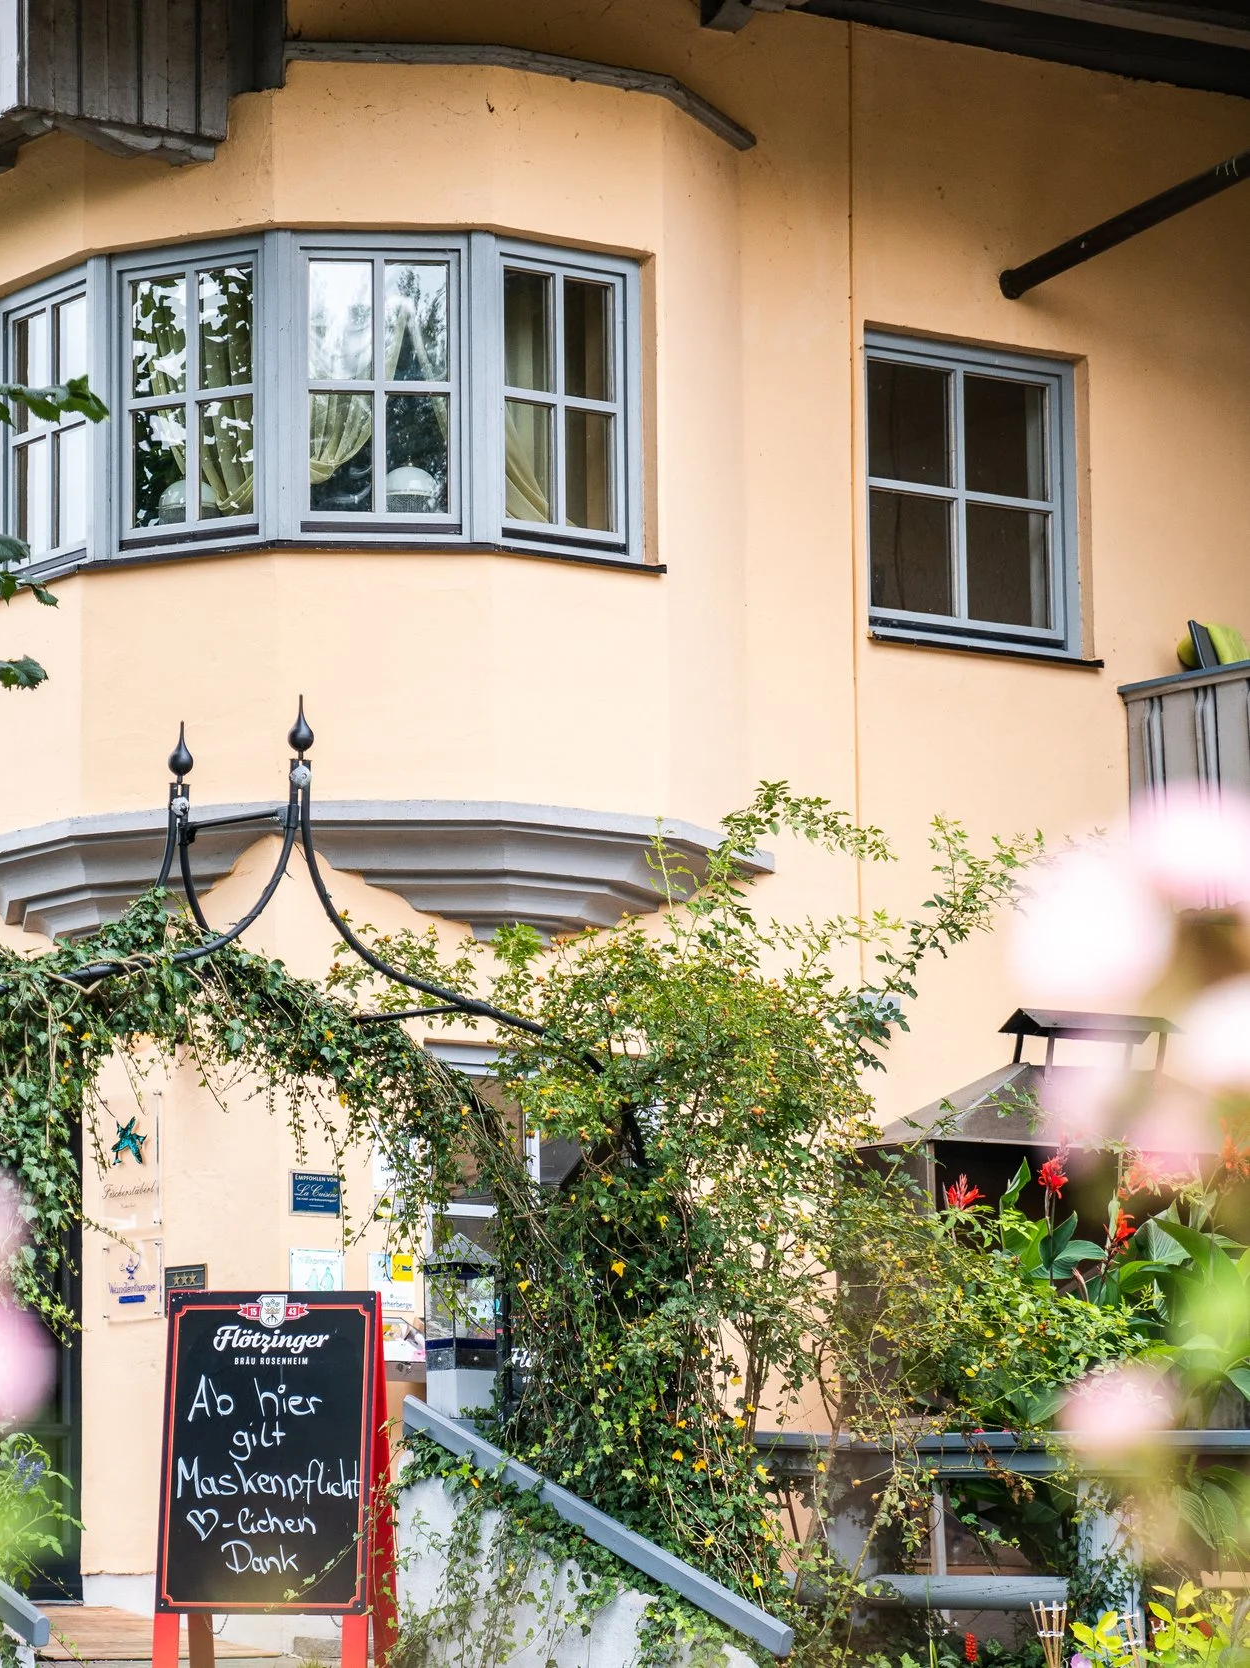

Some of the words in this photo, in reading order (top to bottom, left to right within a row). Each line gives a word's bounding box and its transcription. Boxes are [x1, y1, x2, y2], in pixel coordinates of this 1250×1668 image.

[249, 1307, 257, 1316] 15
[287, 1307, 297, 1316] 43
[213, 1325, 330, 1354] Flötzinger
[234, 1356, 256, 1365] BRÄU
[260, 1357, 309, 1365] ROSENHEIM
[187, 1374, 235, 1422] Ab
[253, 1377, 323, 1417] hier
[229, 1420, 286, 1461] gilt
[176, 1456, 363, 1504] Maskenpflicht
[221, 1540, 299, 1574] Dank
